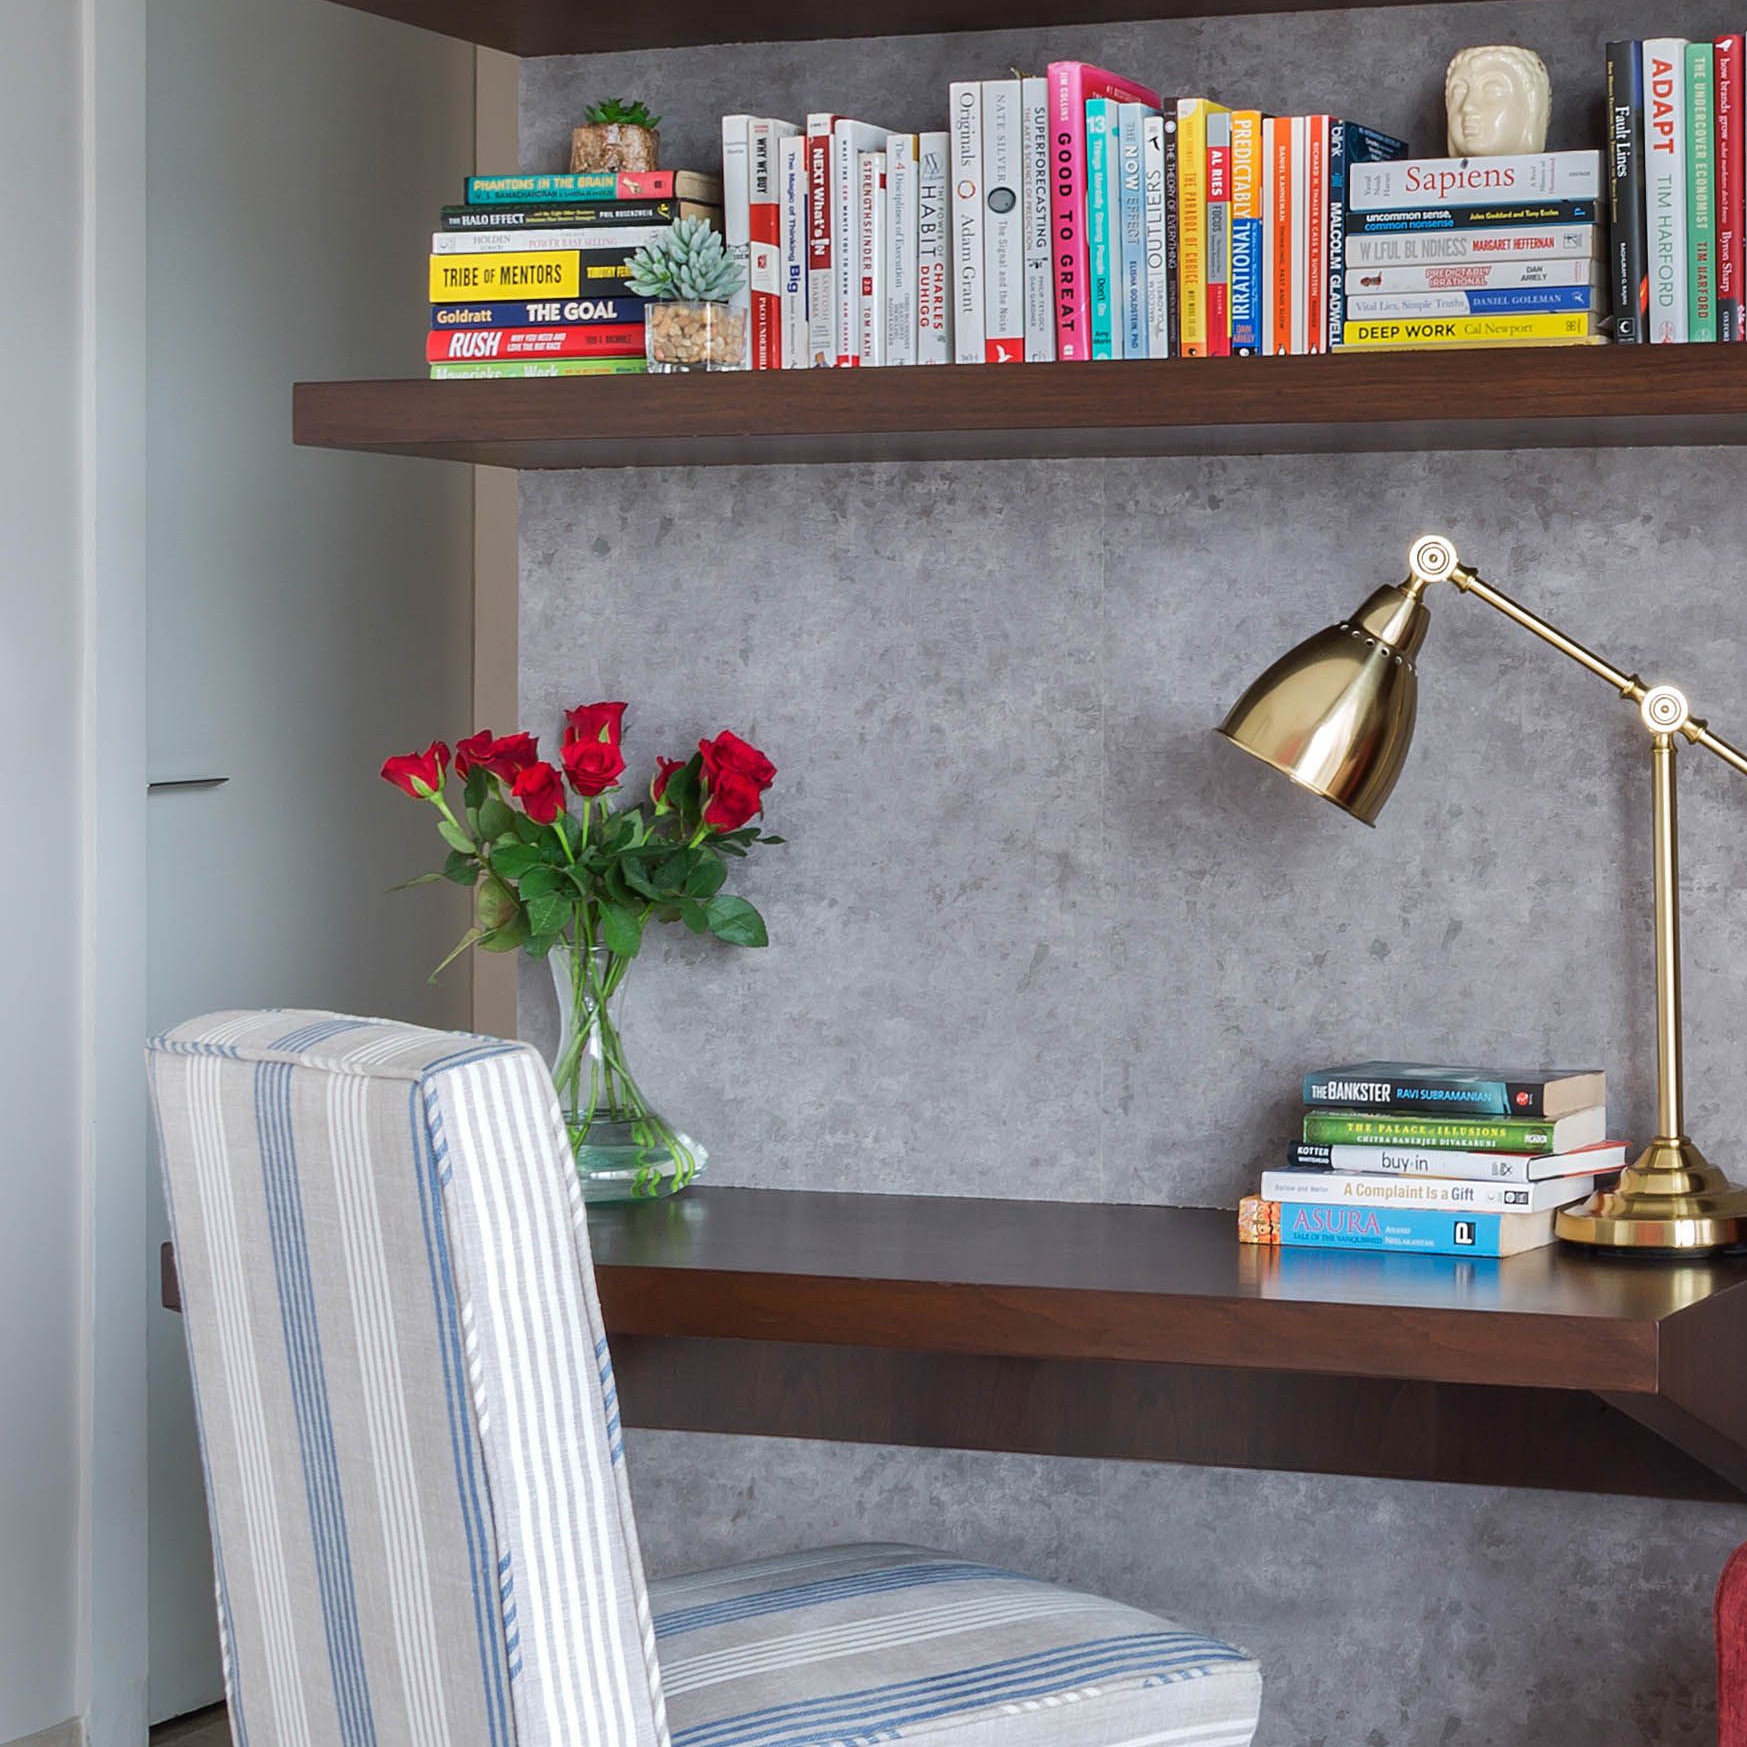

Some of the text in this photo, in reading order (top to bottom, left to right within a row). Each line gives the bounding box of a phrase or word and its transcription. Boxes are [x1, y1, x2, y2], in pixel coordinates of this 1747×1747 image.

[1652, 59, 1674, 154] ADAPT
[960, 92, 975, 166] Originals
[1406, 165, 1515, 199] Sapiens
[922, 185, 937, 256] HABIT
[1058, 133, 1075, 331] GOOD TO GREAT
[1148, 170, 1163, 269] OUTLIERS
[1233, 119, 1253, 320] PREDICTABLY IRRATIONAL
[443, 265, 562, 286] TRIBE OF MENTORS
[526, 302, 617, 321] THE GOAL
[920, 266, 930, 328] DUHIGG
[933, 263, 943, 330] CHARLES
[437, 310, 492, 324] Goldratt
[1359, 325, 1456, 339] DEEP WORK
[449, 332, 502, 357] RUSH
[1312, 1083, 1391, 1101] THE BANKSTER
[1344, 1183, 1474, 1201] A Complaint Is a Gift
[1294, 1210, 1380, 1233] ASURA
